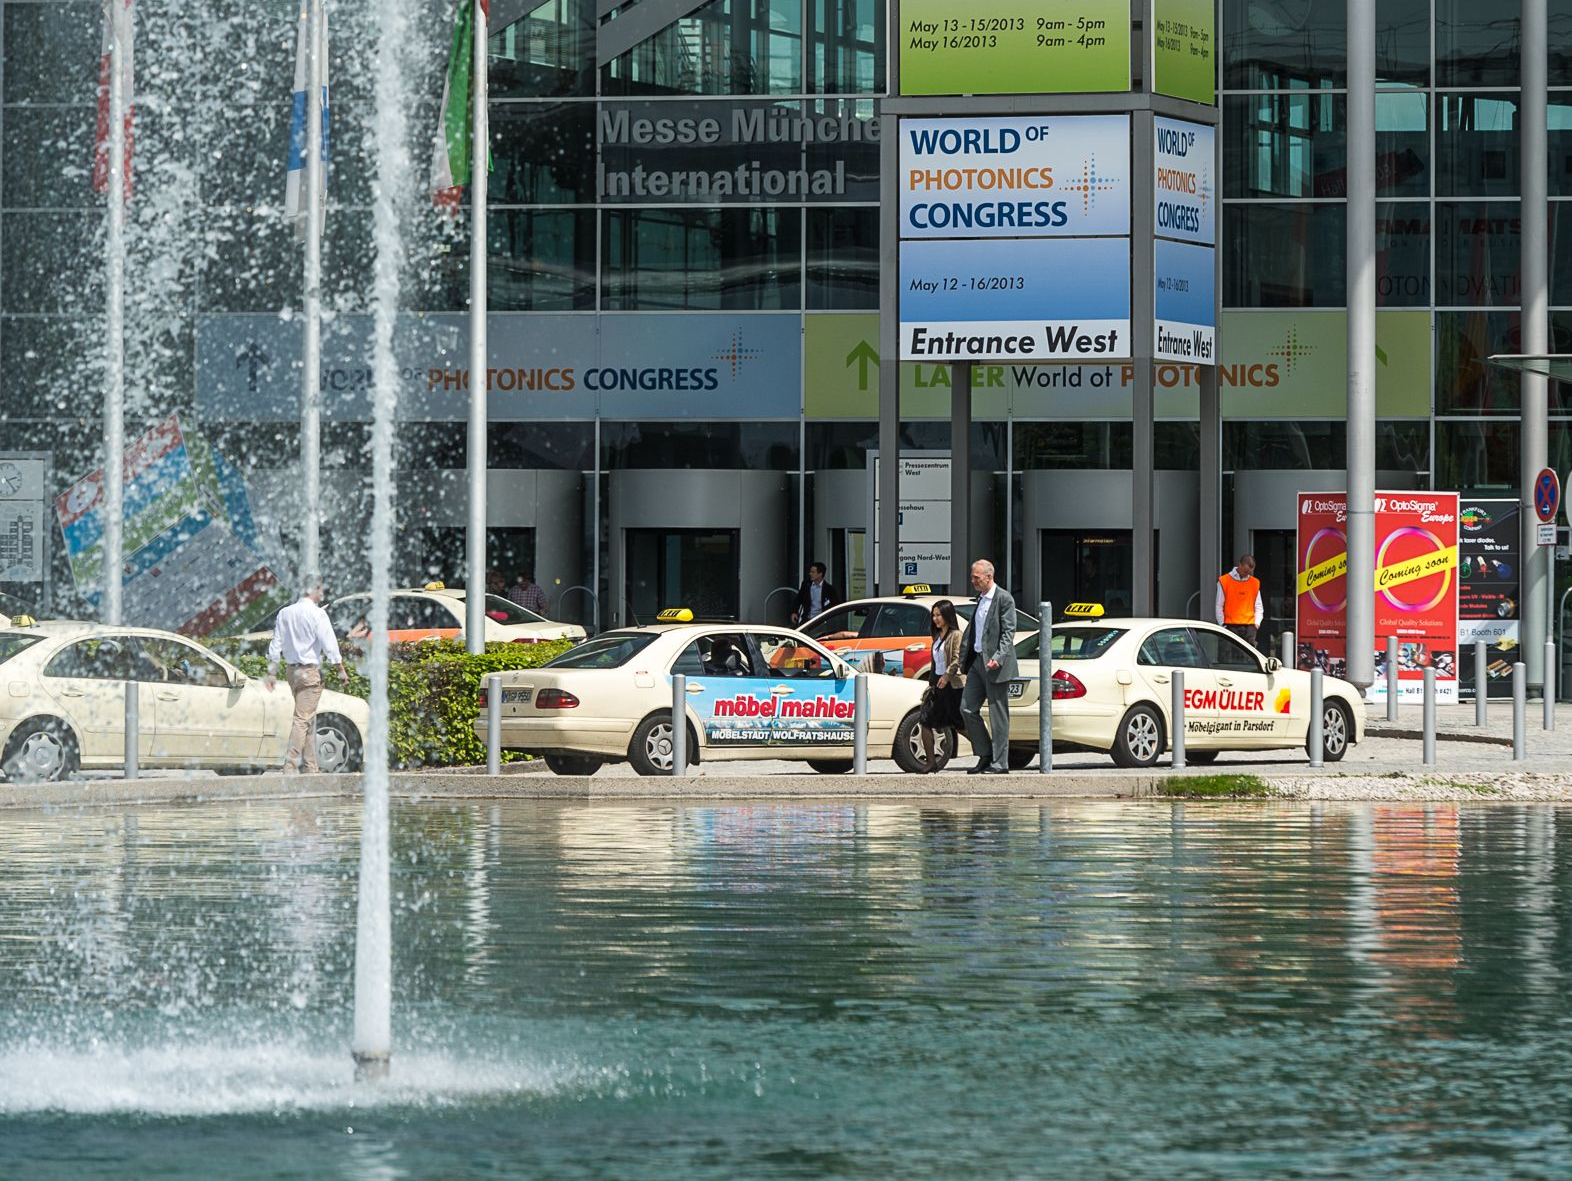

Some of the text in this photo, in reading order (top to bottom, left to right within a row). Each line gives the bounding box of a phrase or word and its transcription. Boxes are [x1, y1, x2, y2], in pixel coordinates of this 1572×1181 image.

[910, 20, 939, 35] May
[943, 20, 958, 32] 13
[1036, 18, 1065, 30] 9am
[1076, 18, 1105, 33] 5pm
[910, 36, 939, 52] May
[942, 36, 997, 48] 16/2013
[1036, 35, 1065, 47] 9am
[1076, 34, 1105, 49] 4pm
[600, 108, 881, 144] Messe Münche
[910, 126, 1049, 155] WORLD OF
[1157, 127, 1195, 158] WORLD OF
[600, 160, 845, 196] International
[910, 167, 1054, 191] PHOTONICS
[1157, 167, 1196, 195] PHOTONICS
[909, 201, 1068, 229] CONGRESS
[1157, 201, 1200, 233] CONGRESS
[910, 279, 939, 294] May
[942, 279, 958, 291] 12
[970, 277, 1025, 290] 16/2013
[910, 326, 1118, 355] Entrance West
[1158, 326, 1213, 358] Entrance West
[428, 368, 575, 391] PHTONICS
[583, 368, 719, 391] CONGRESS
[914, 364, 1280, 388] LAER World of POTNICS
[1314, 500, 1347, 512] OptoSigma
[1390, 500, 1437, 512] OptoSigma
[1421, 511, 1455, 524] Europe
[1306, 560, 1347, 587] Coming so
[1379, 555, 1449, 586] Coming soon
[1399, 619, 1418, 628] Quality
[1471, 628, 1492, 636] Booth
[1493, 628, 1506, 636] 601
[714, 695, 855, 718] möbel mahler
[1184, 689, 1264, 711] EGMÜLLER
[773, 730, 855, 741] WOLFRATSHAUSE
[1188, 721, 1232, 735] Möbelgigant
[1234, 720, 1241, 731] in
[1243, 720, 1275, 732] Parsdorf
